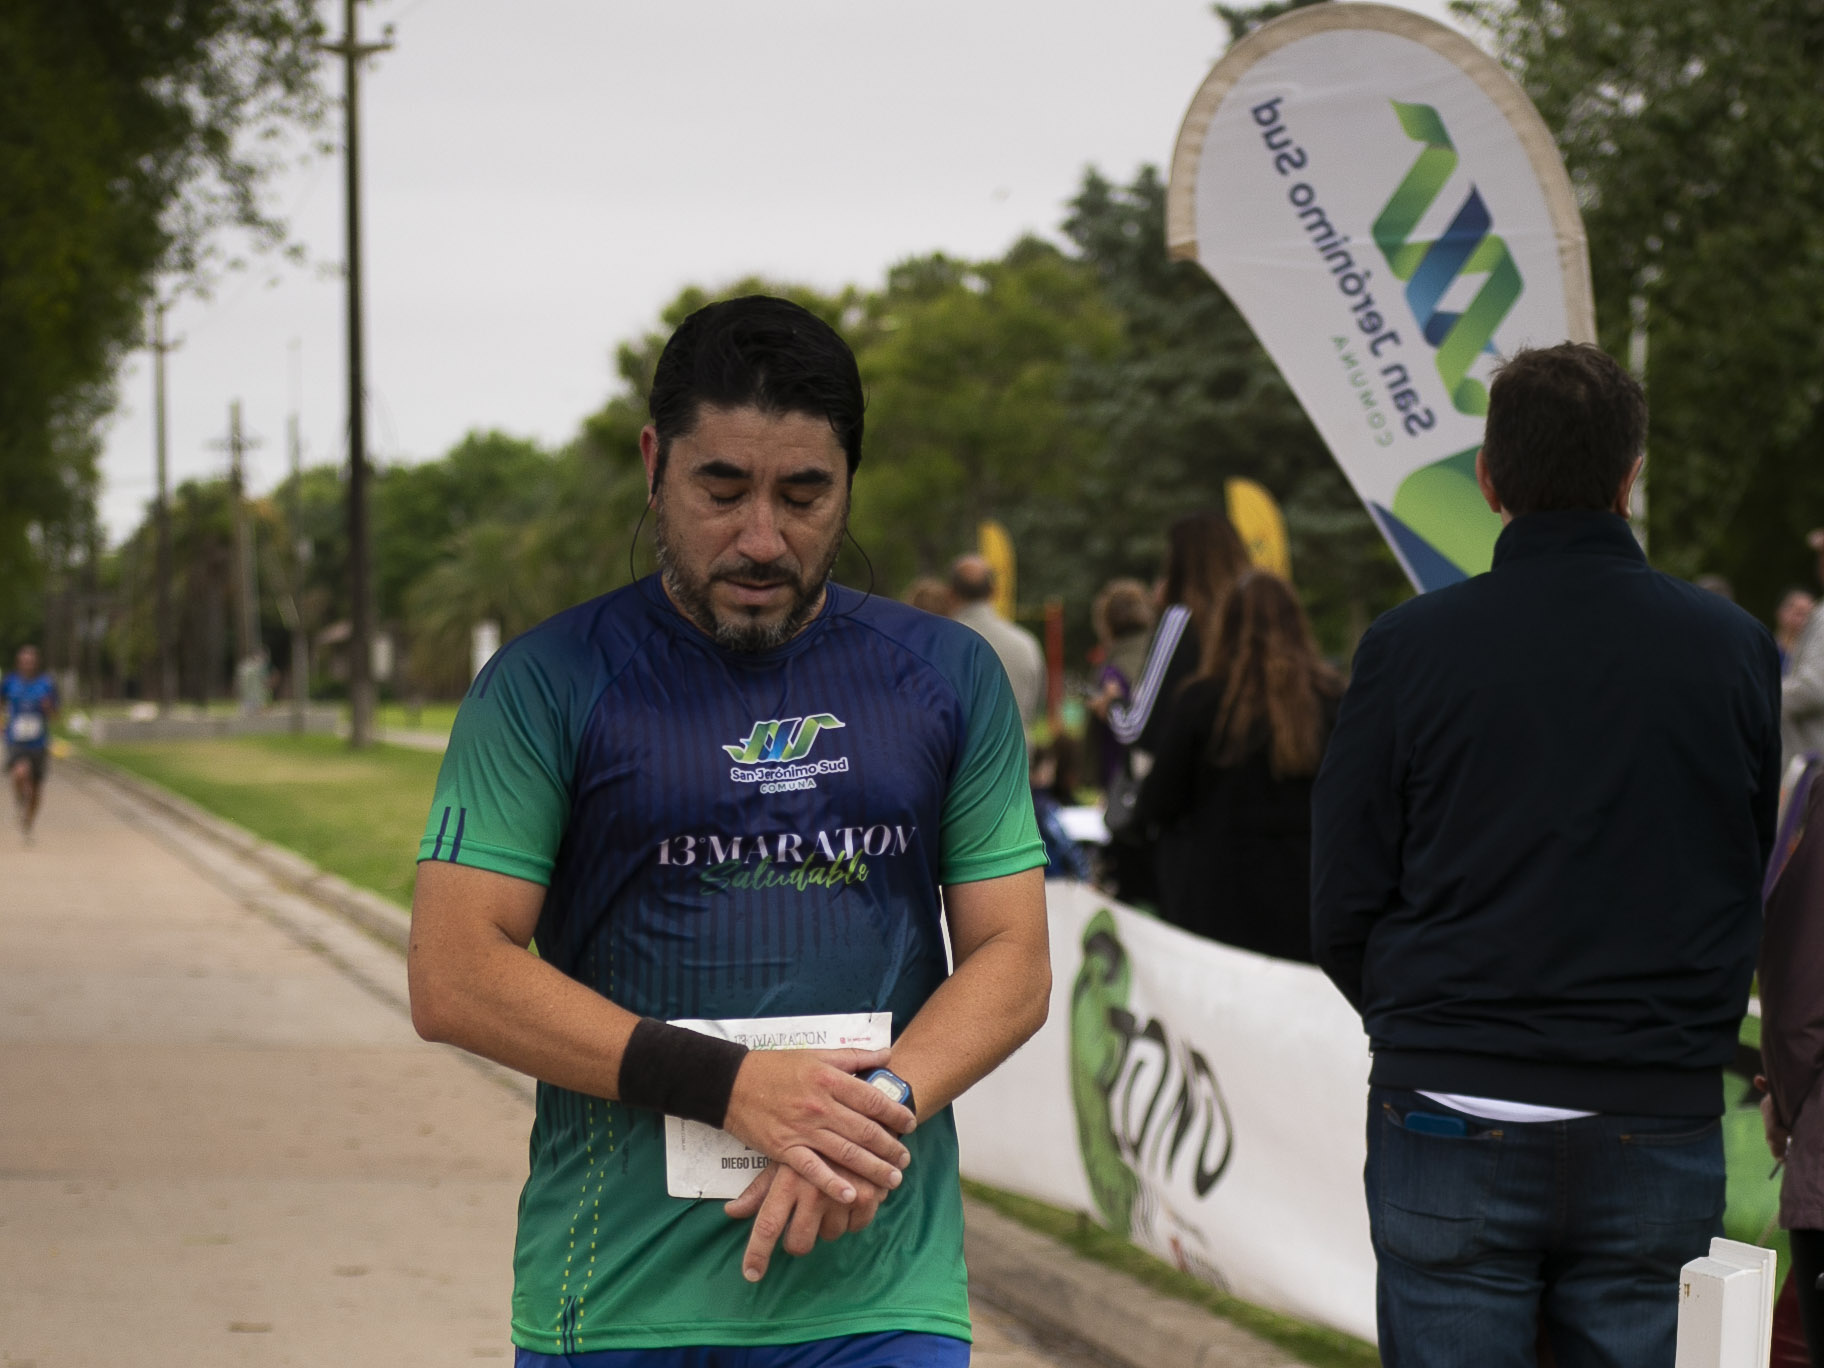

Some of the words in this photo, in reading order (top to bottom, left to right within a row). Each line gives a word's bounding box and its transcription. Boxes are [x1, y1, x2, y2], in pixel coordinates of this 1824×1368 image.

[731, 768, 756, 781] San
[756, 764, 818, 781] Jerónimo
[819, 758, 848, 773] Sud
[760, 779, 816, 793] COMUNA
[700, 847, 870, 896] Saludable
[721, 1157, 750, 1169] DIEGO
[751, 1156, 772, 1169] LEO
